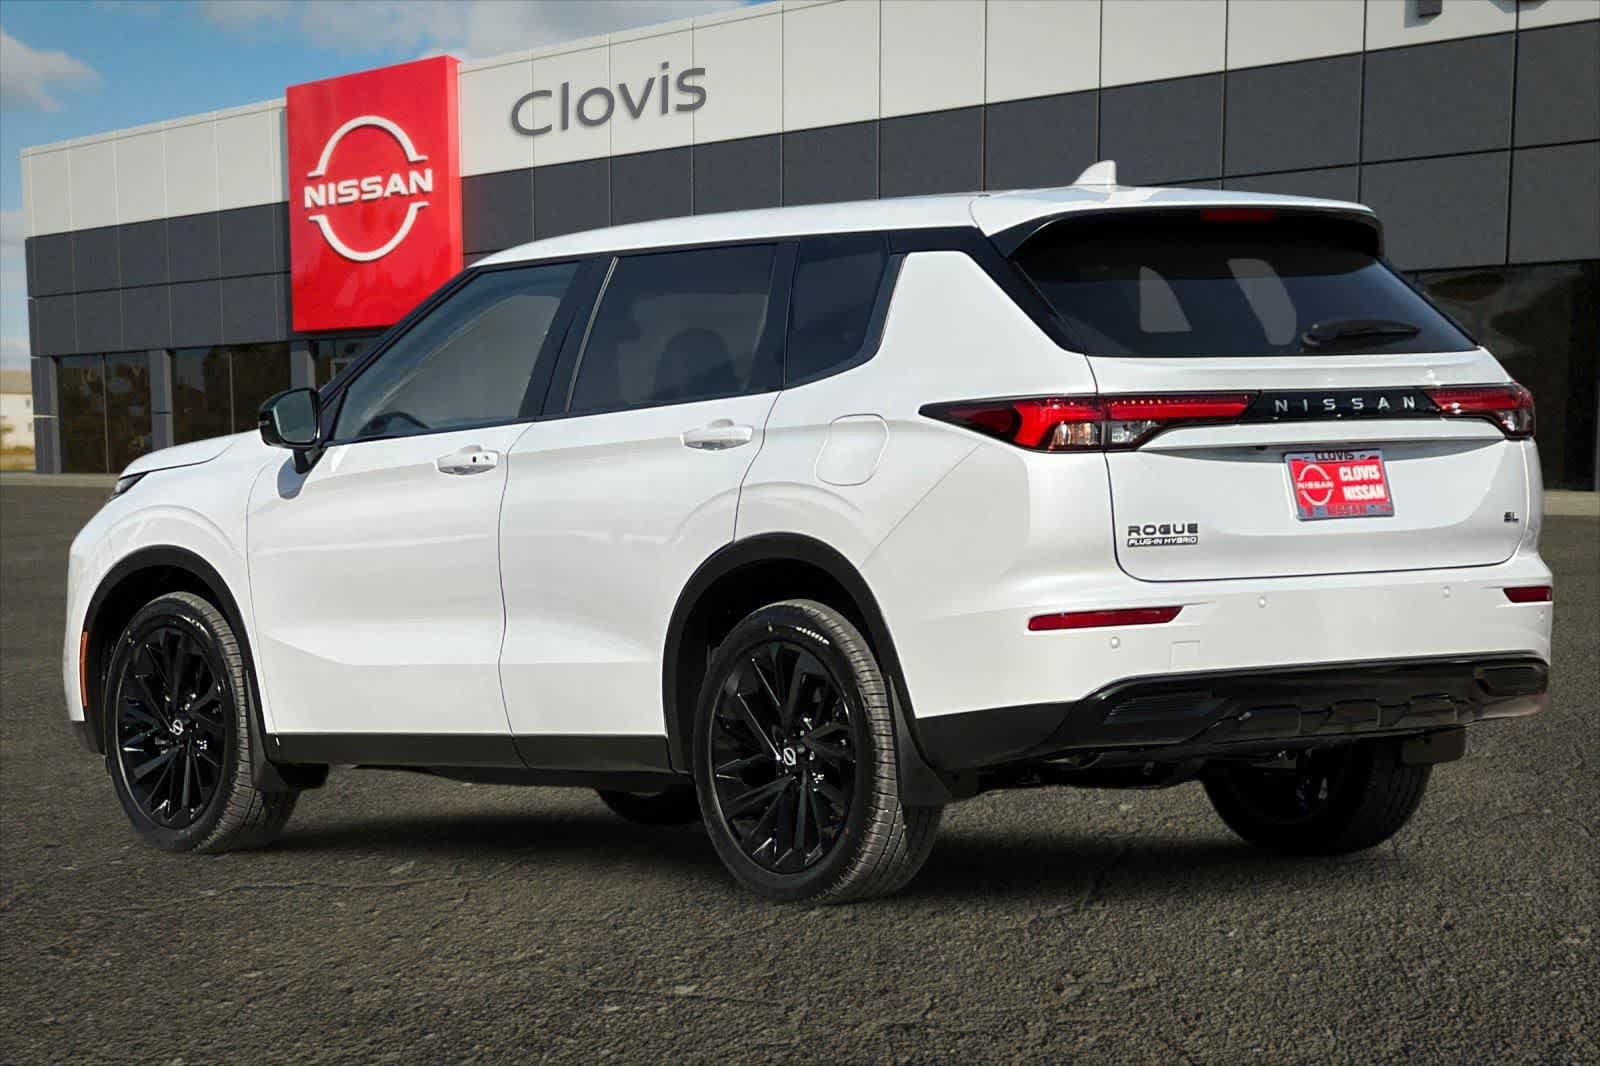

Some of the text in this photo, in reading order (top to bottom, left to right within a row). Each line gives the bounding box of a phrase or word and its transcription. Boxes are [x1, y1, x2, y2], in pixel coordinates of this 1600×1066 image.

[511, 61, 707, 136] Clovis
[304, 168, 433, 208] NISSAN
[1274, 396, 1416, 412] NISSAN
[1339, 465, 1380, 482] CLOVIS
[1296, 480, 1334, 490] NISSAN
[1342, 484, 1386, 501] NISSAN
[1127, 523, 1198, 537] ROGUE
[1128, 537, 1197, 546] PLUG-IN HYBRID
